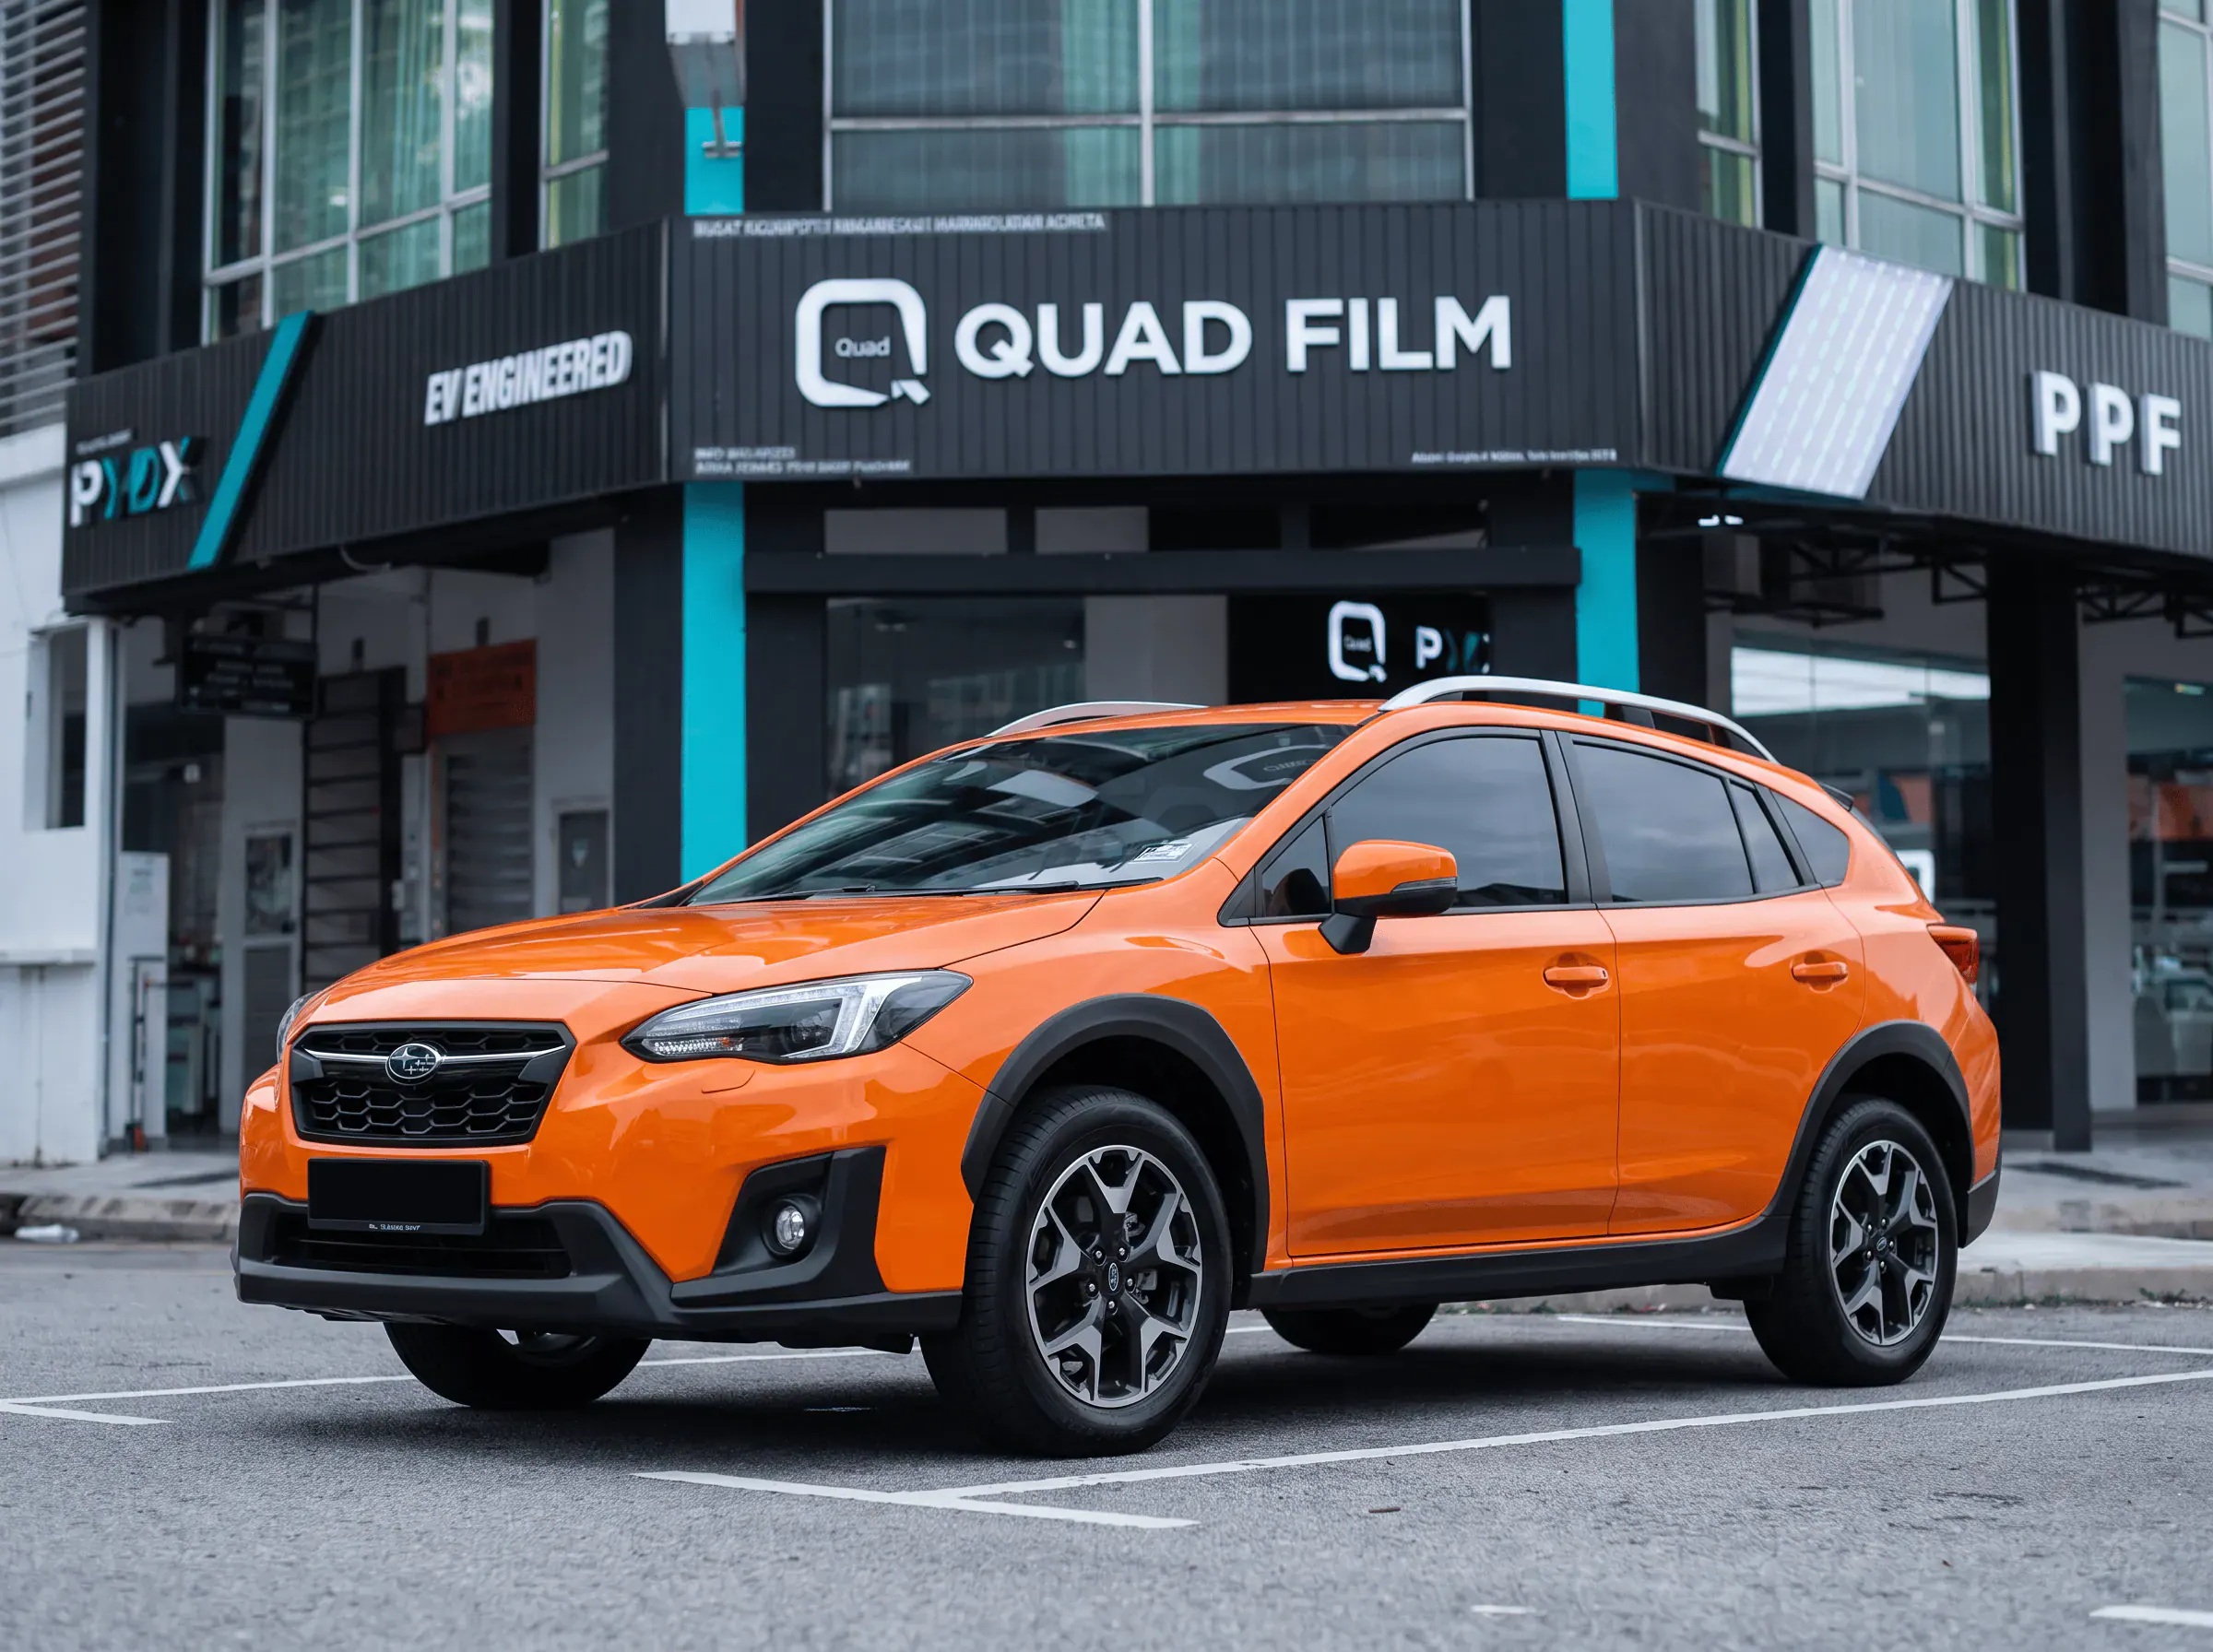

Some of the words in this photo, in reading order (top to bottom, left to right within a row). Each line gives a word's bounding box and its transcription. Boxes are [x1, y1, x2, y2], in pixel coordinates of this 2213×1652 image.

[424, 368, 463, 426] EV
[462, 330, 633, 419] ENGINEERED
[834, 336, 891, 358] Quad
[954, 300, 1253, 378] QUAD
[1285, 295, 1511, 372] FILM
[2031, 370, 2183, 476] PPF
